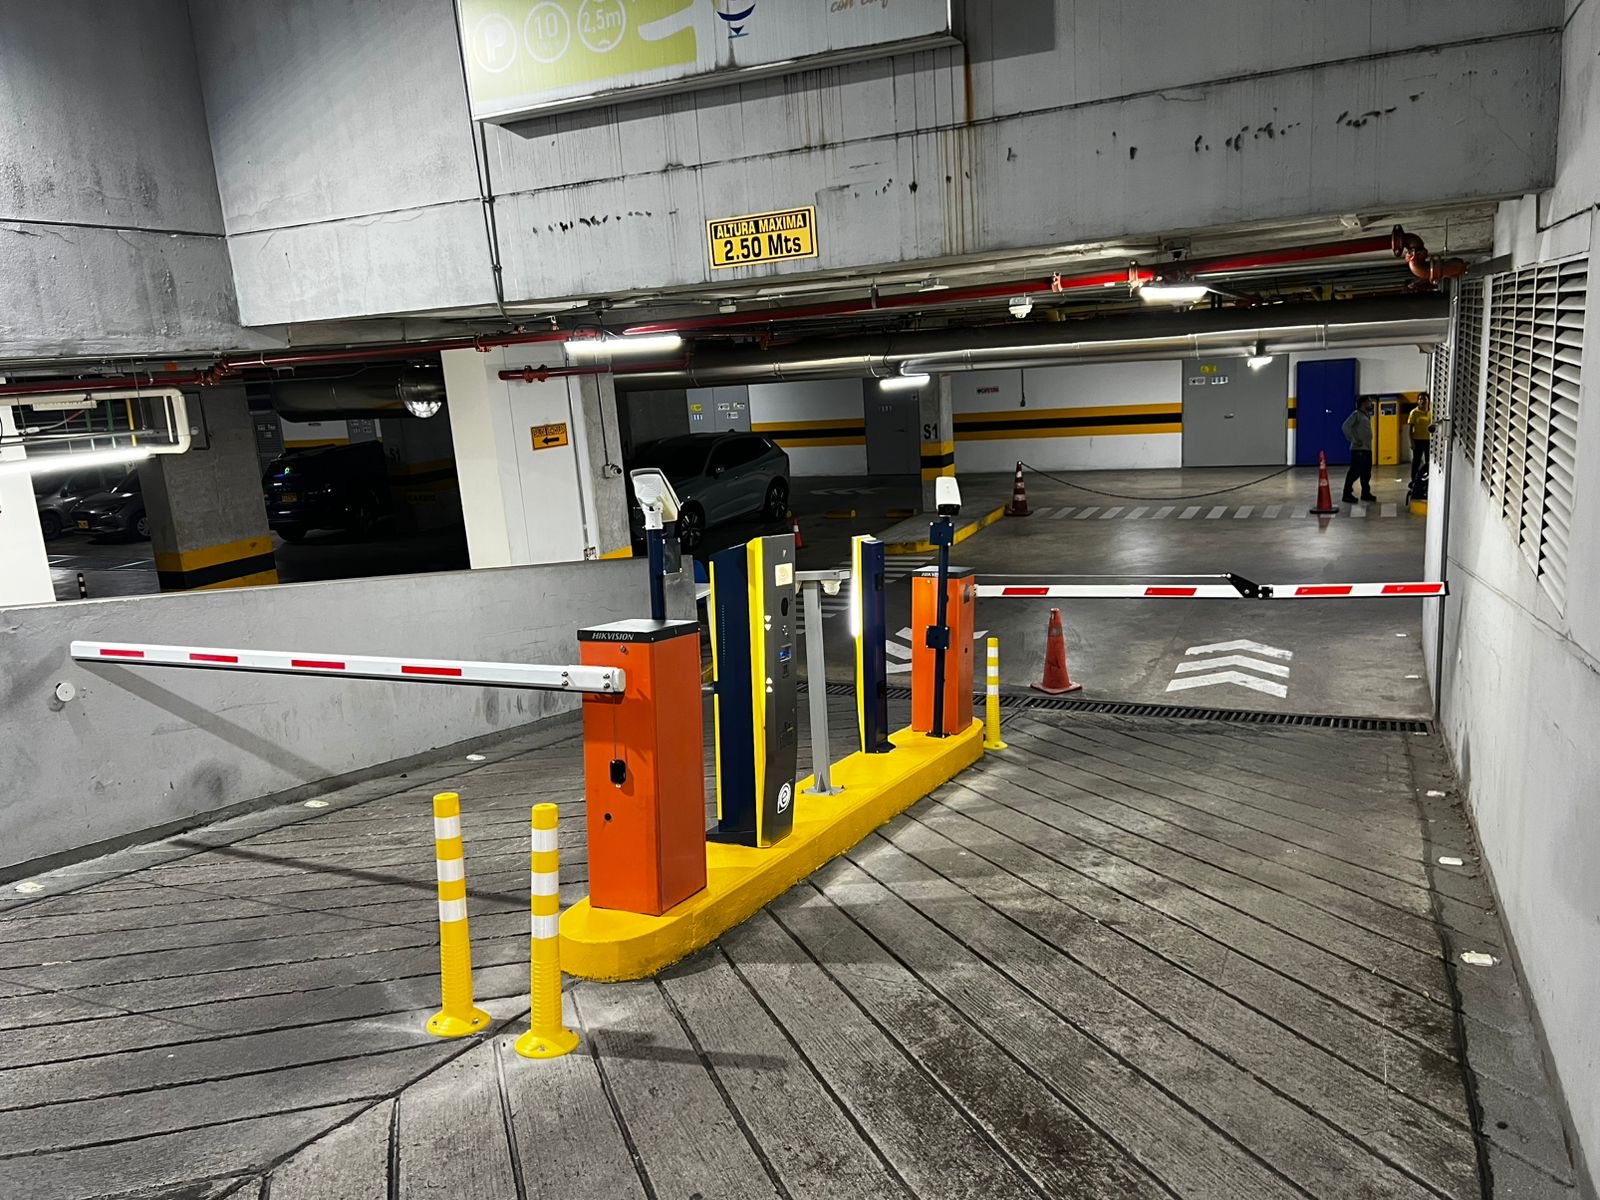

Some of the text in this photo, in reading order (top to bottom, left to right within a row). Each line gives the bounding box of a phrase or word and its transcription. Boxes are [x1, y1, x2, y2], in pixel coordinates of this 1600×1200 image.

[534, 12, 559, 40] 10
[716, 213, 805, 239] ALTURA MAXIMA
[724, 233, 802, 261] 2.50 Mts
[923, 423, 938, 440] S1
[592, 632, 635, 641] HIKVISION
